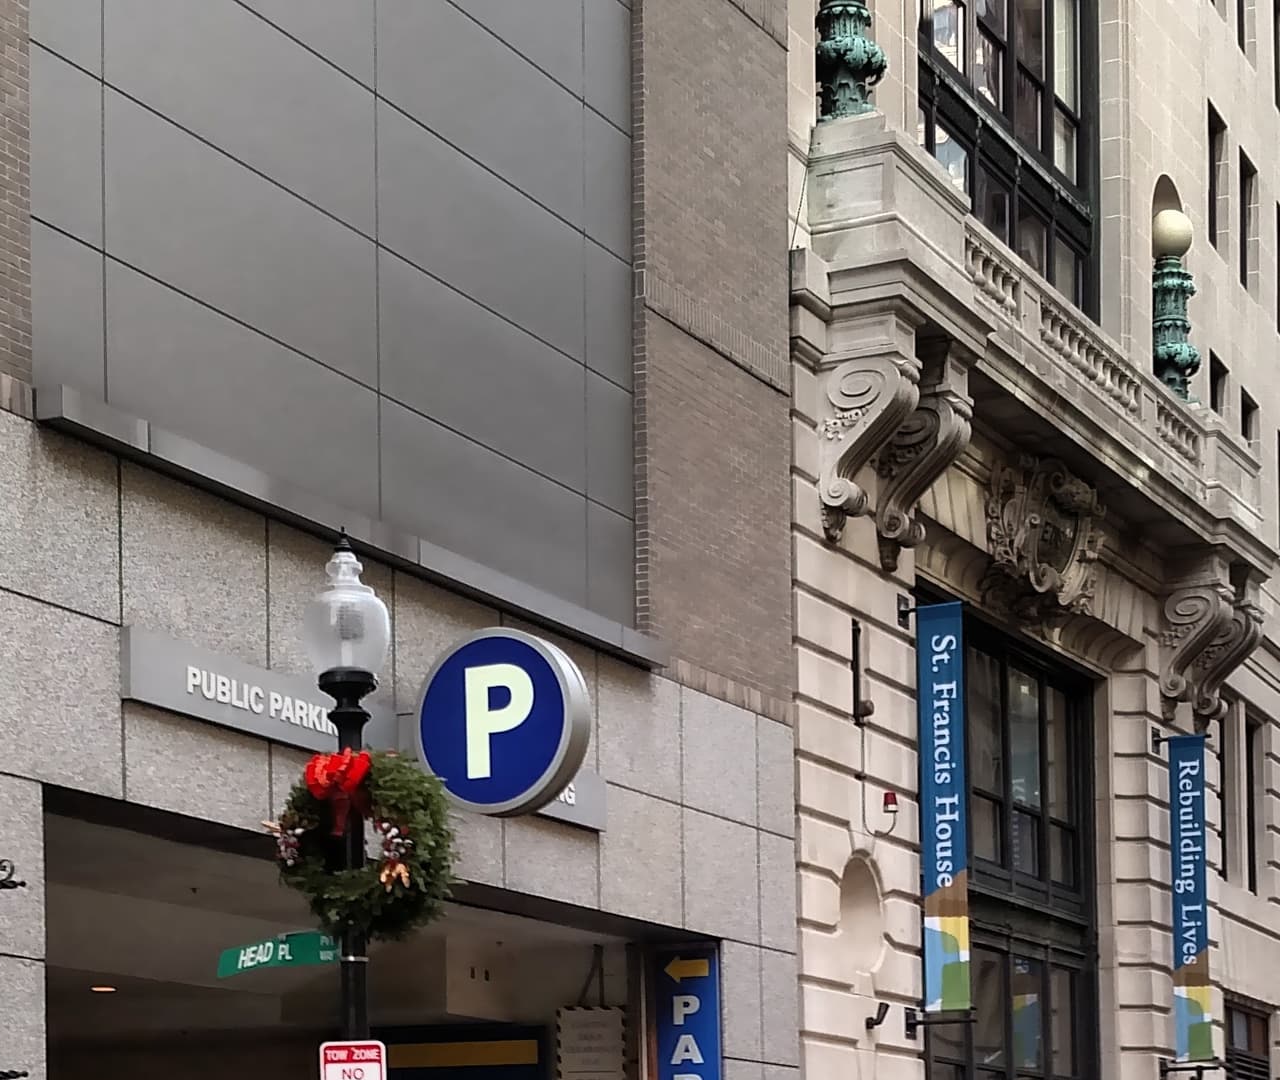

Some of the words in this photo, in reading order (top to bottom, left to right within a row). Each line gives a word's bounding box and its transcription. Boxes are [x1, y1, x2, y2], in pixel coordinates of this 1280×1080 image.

[931, 634, 956, 673] St.
[187, 666, 264, 713] PUBLIC
[465, 663, 535, 780] P
[931, 681, 957, 785] Francis
[935, 797, 960, 889] House
[1175, 760, 1201, 894] Rebuilding
[238, 942, 273, 968] HEAD
[277, 943, 293, 960] PL
[1181, 904, 1202, 966] Lives
[325, 1050, 348, 1060] TOW
[351, 1048, 380, 1060] ZONE
[342, 1068, 364, 1080] NO
